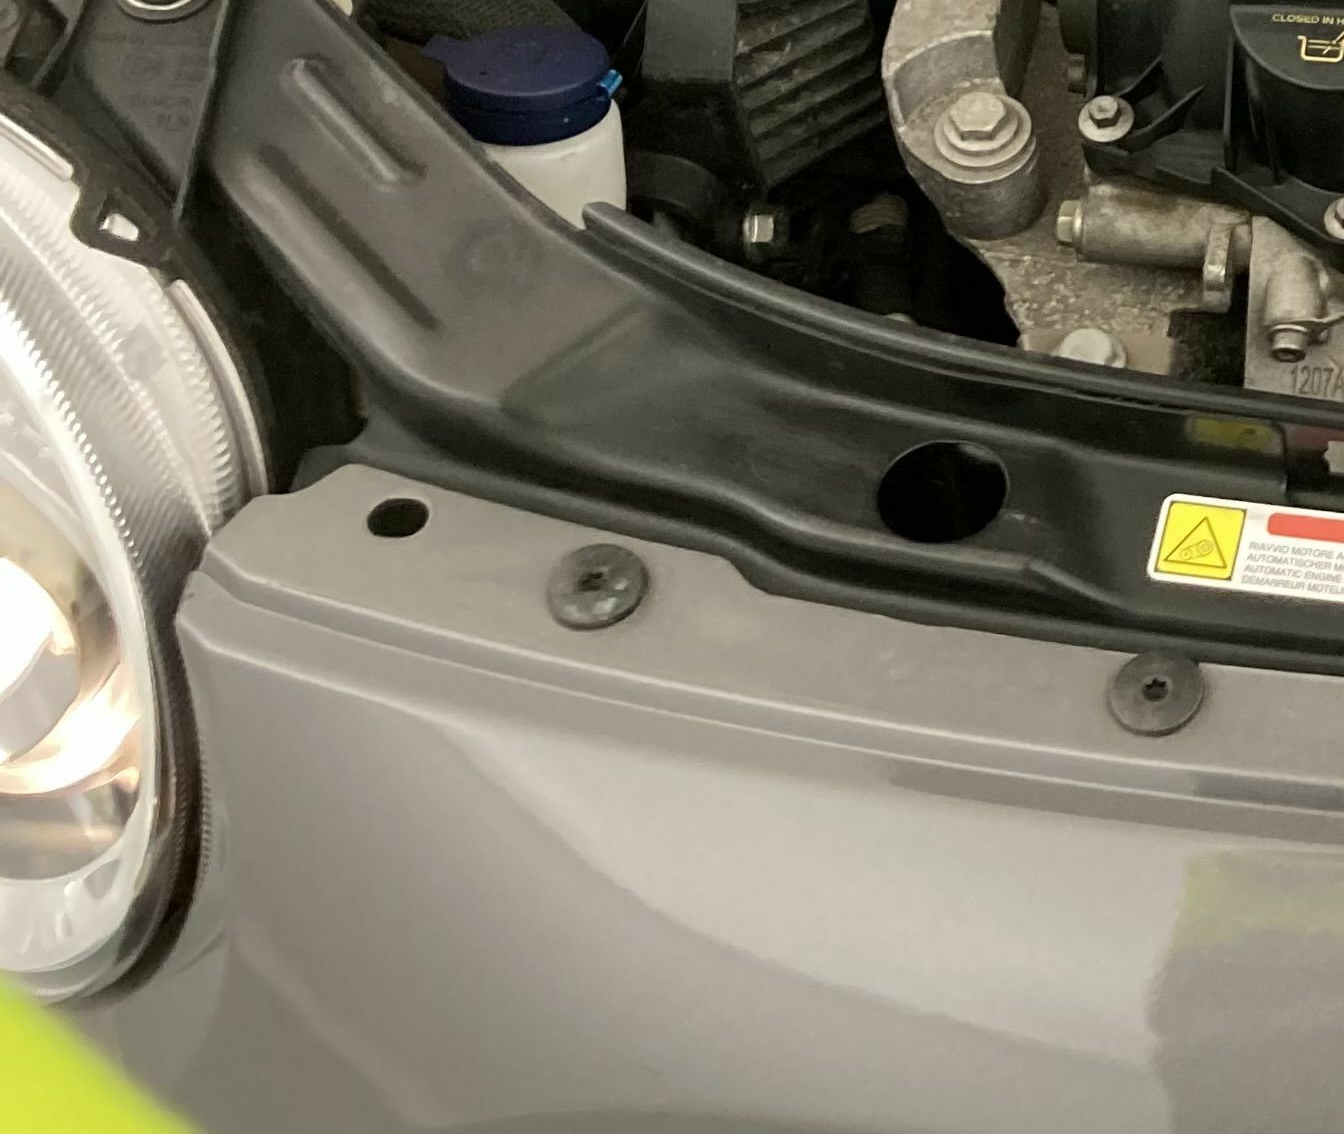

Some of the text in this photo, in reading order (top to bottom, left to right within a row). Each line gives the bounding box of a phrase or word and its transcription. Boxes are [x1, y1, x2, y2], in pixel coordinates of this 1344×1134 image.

[1271, 13, 1320, 24] CLOSED
[1322, 16, 1334, 25] IN
[1249, 541, 1289, 554] RIAVVIO
[1291, 546, 1334, 559] MOTORE
[1246, 552, 1332, 570] AUTOMATISCHER
[1241, 575, 1305, 590] DEMARREUR
[1244, 564, 1302, 578] AUTOMATIC
[1305, 571, 1342, 583] ENGINE
